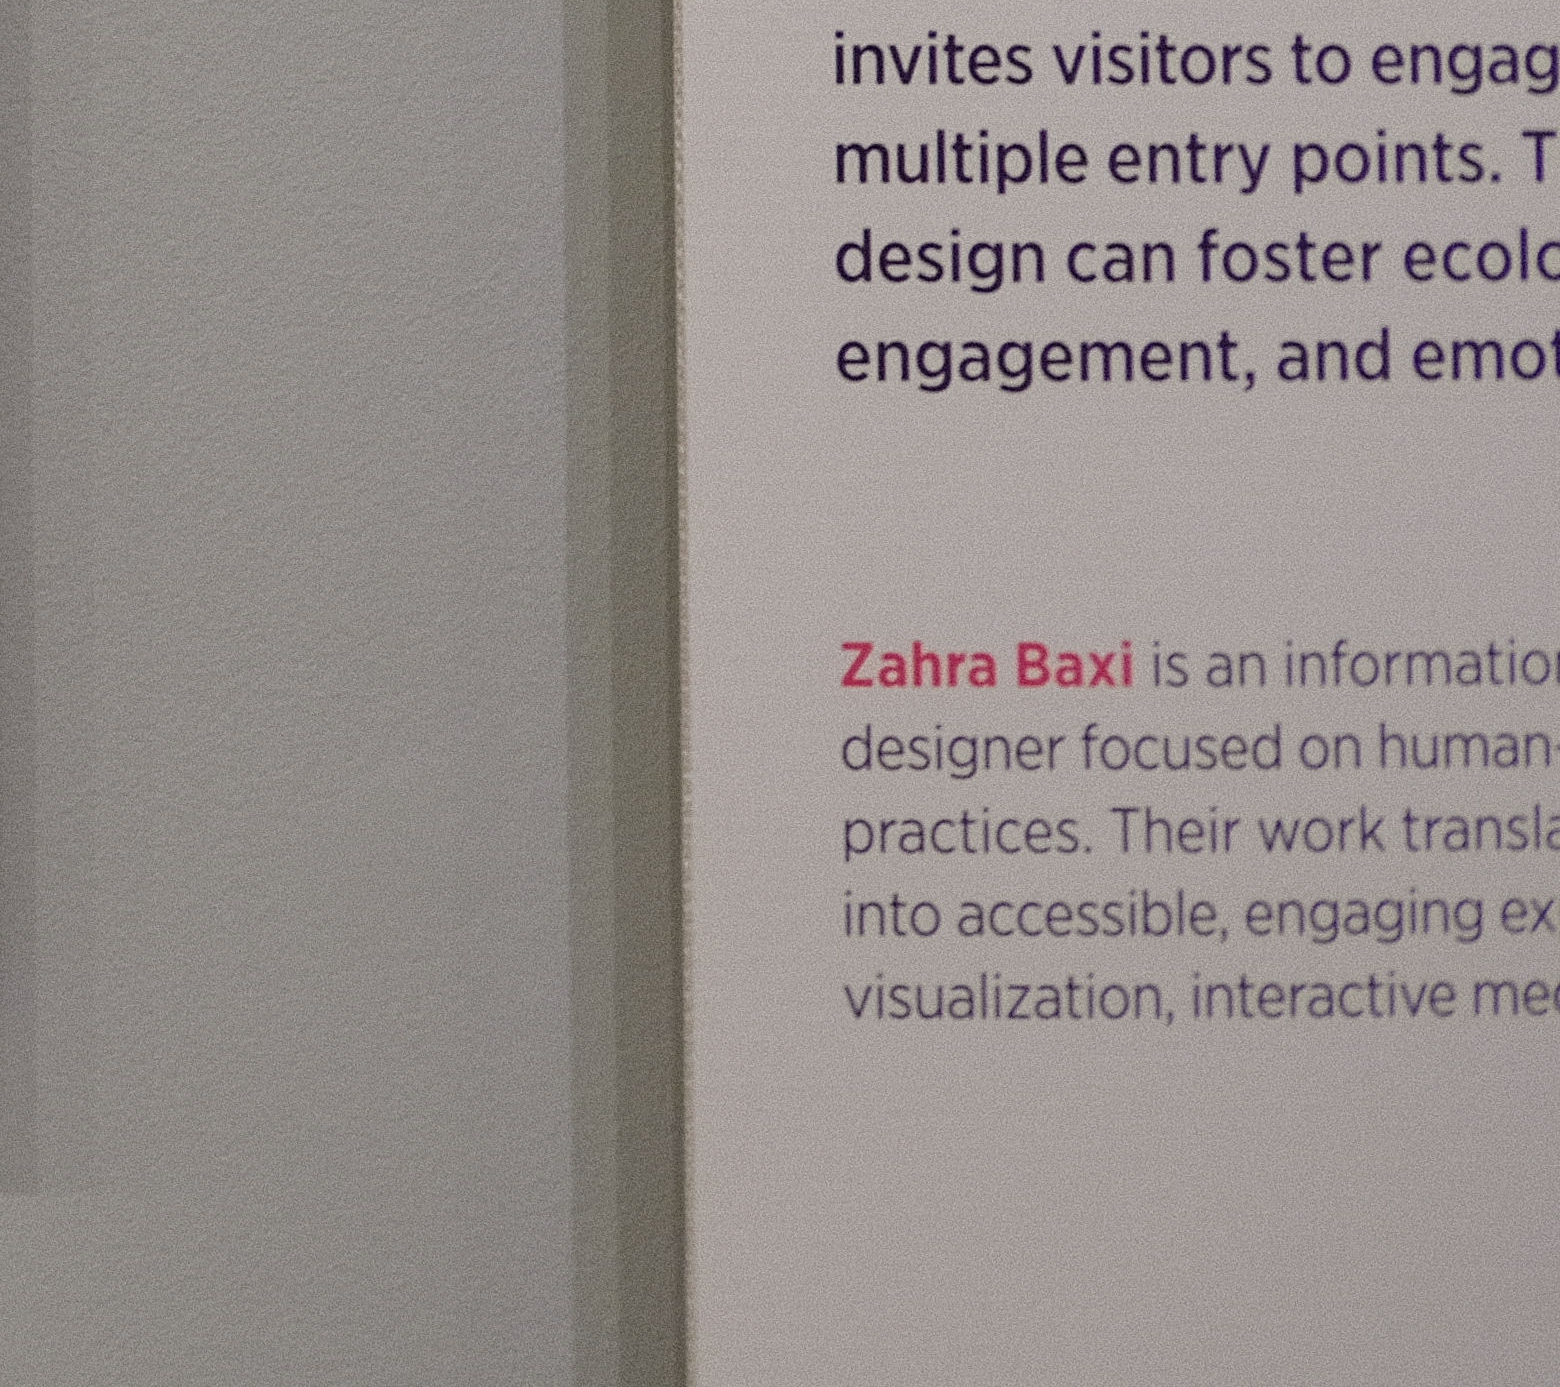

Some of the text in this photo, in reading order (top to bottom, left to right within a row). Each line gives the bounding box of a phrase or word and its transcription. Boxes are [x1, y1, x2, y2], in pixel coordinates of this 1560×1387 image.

[842, 641, 1266, 688] Zahra Baxi is an
